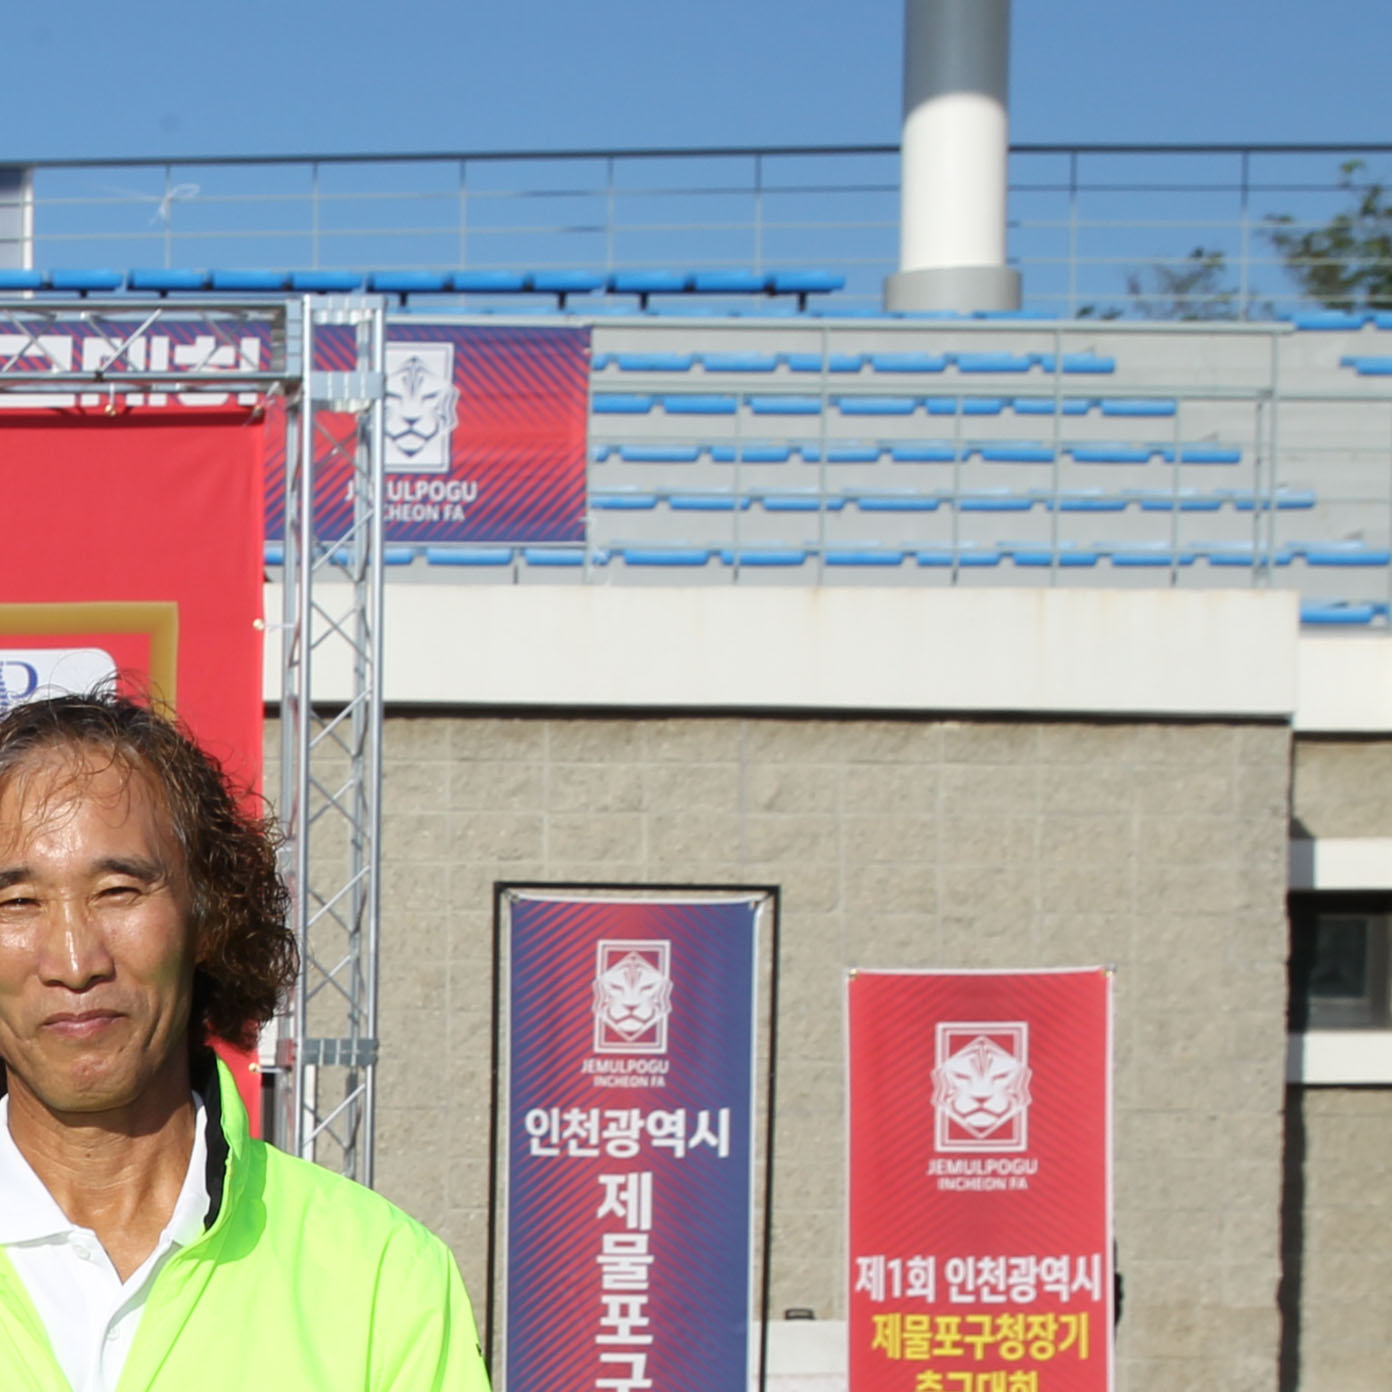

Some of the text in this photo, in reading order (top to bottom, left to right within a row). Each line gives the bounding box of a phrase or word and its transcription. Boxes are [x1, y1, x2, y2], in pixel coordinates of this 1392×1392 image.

[442, 504, 466, 521] FA
[580, 1058, 670, 1076] JEMULPOGU
[592, 1074, 650, 1089] INCHEON
[523, 1106, 731, 1159] 인천광역시
[926, 1158, 1039, 1176] JEMULPOGU
[937, 1176, 1028, 1191] INCHEON FA
[855, 1253, 1103, 1303] 제1회 인천광역시
[871, 1312, 1089, 1361] 제물포구청장기
